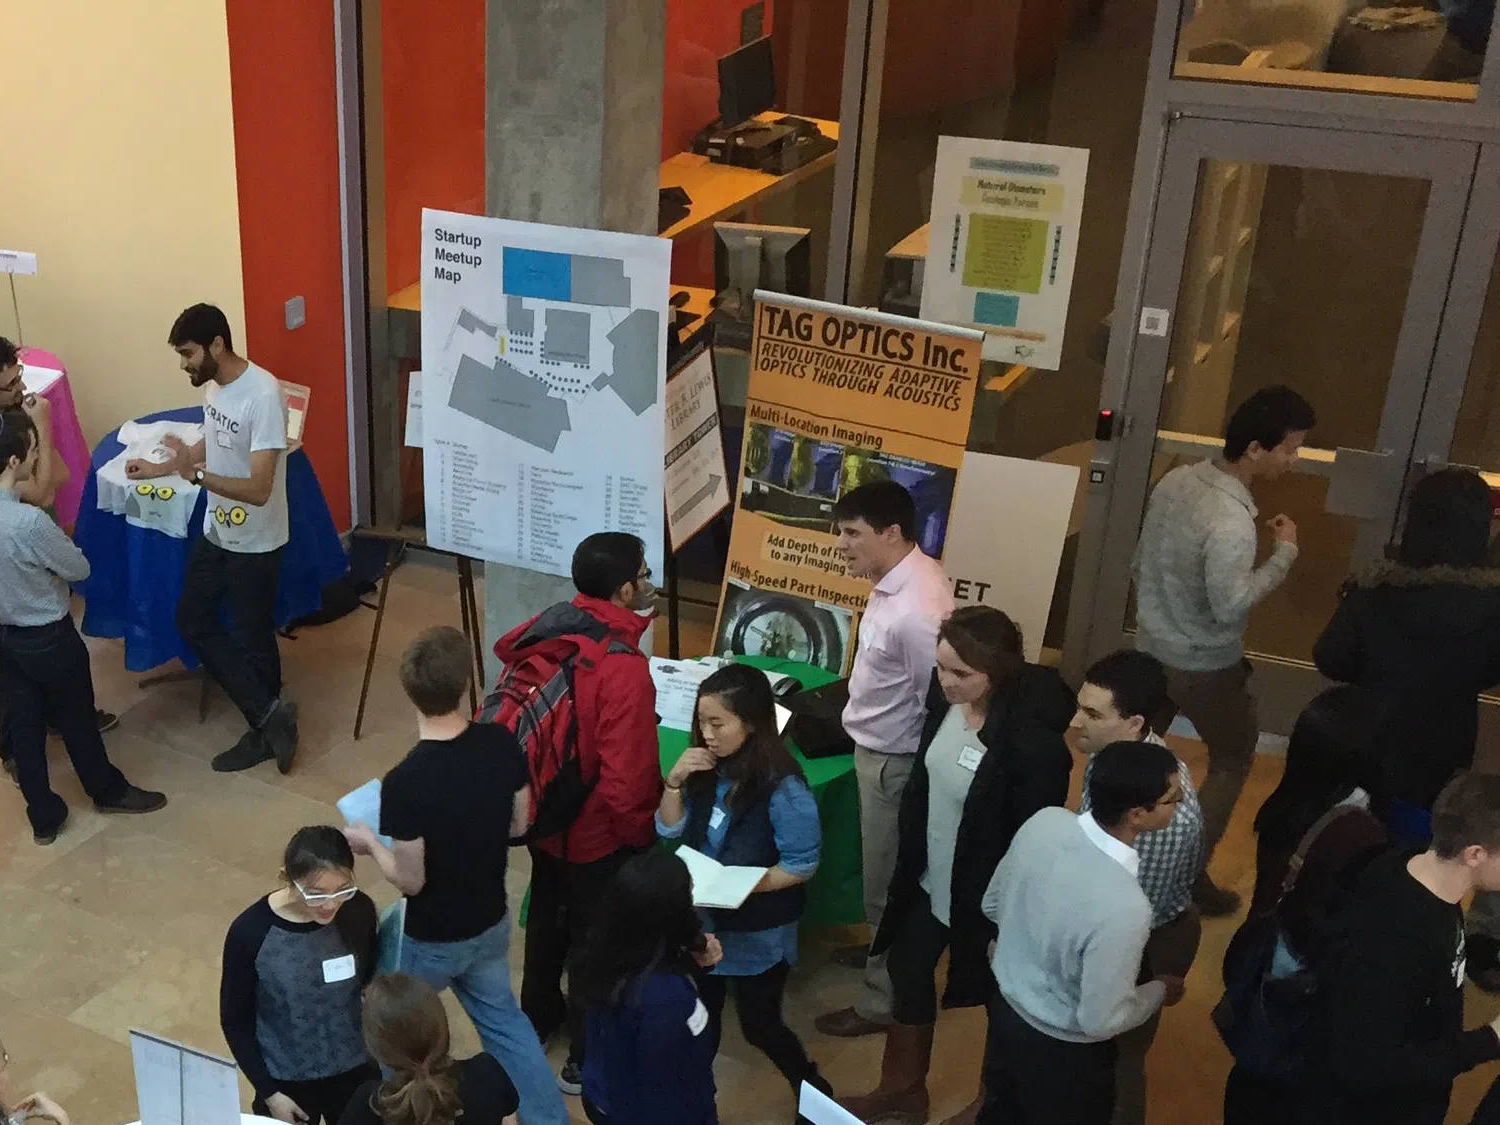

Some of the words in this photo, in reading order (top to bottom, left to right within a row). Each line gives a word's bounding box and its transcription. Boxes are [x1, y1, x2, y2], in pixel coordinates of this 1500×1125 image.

[977, 179, 1008, 193] Natural
[434, 227, 482, 250] Startup
[434, 246, 483, 269] Meetup
[434, 265, 462, 285] Map
[764, 305, 813, 342] TAG
[821, 315, 916, 362] OPTICS
[922, 336, 969, 374] Inc.
[761, 342, 886, 380] REVOLUTIONIZING
[889, 367, 963, 396] ADAPTIVE
[760, 357, 807, 379] OPTICS
[812, 367, 881, 395] THROUGH
[883, 383, 962, 412] ACOUSTICS
[750, 404, 829, 437] Multi-Location
[832, 424, 884, 450] Imaging
[767, 533, 785, 548] Add
[787, 537, 819, 556] Depth
[820, 543, 833, 556] of
[770, 549, 781, 560] to
[782, 553, 803, 566] any
[804, 554, 846, 576] Imaging
[730, 559, 788, 589] High-Speed
[790, 578, 816, 596] Part
